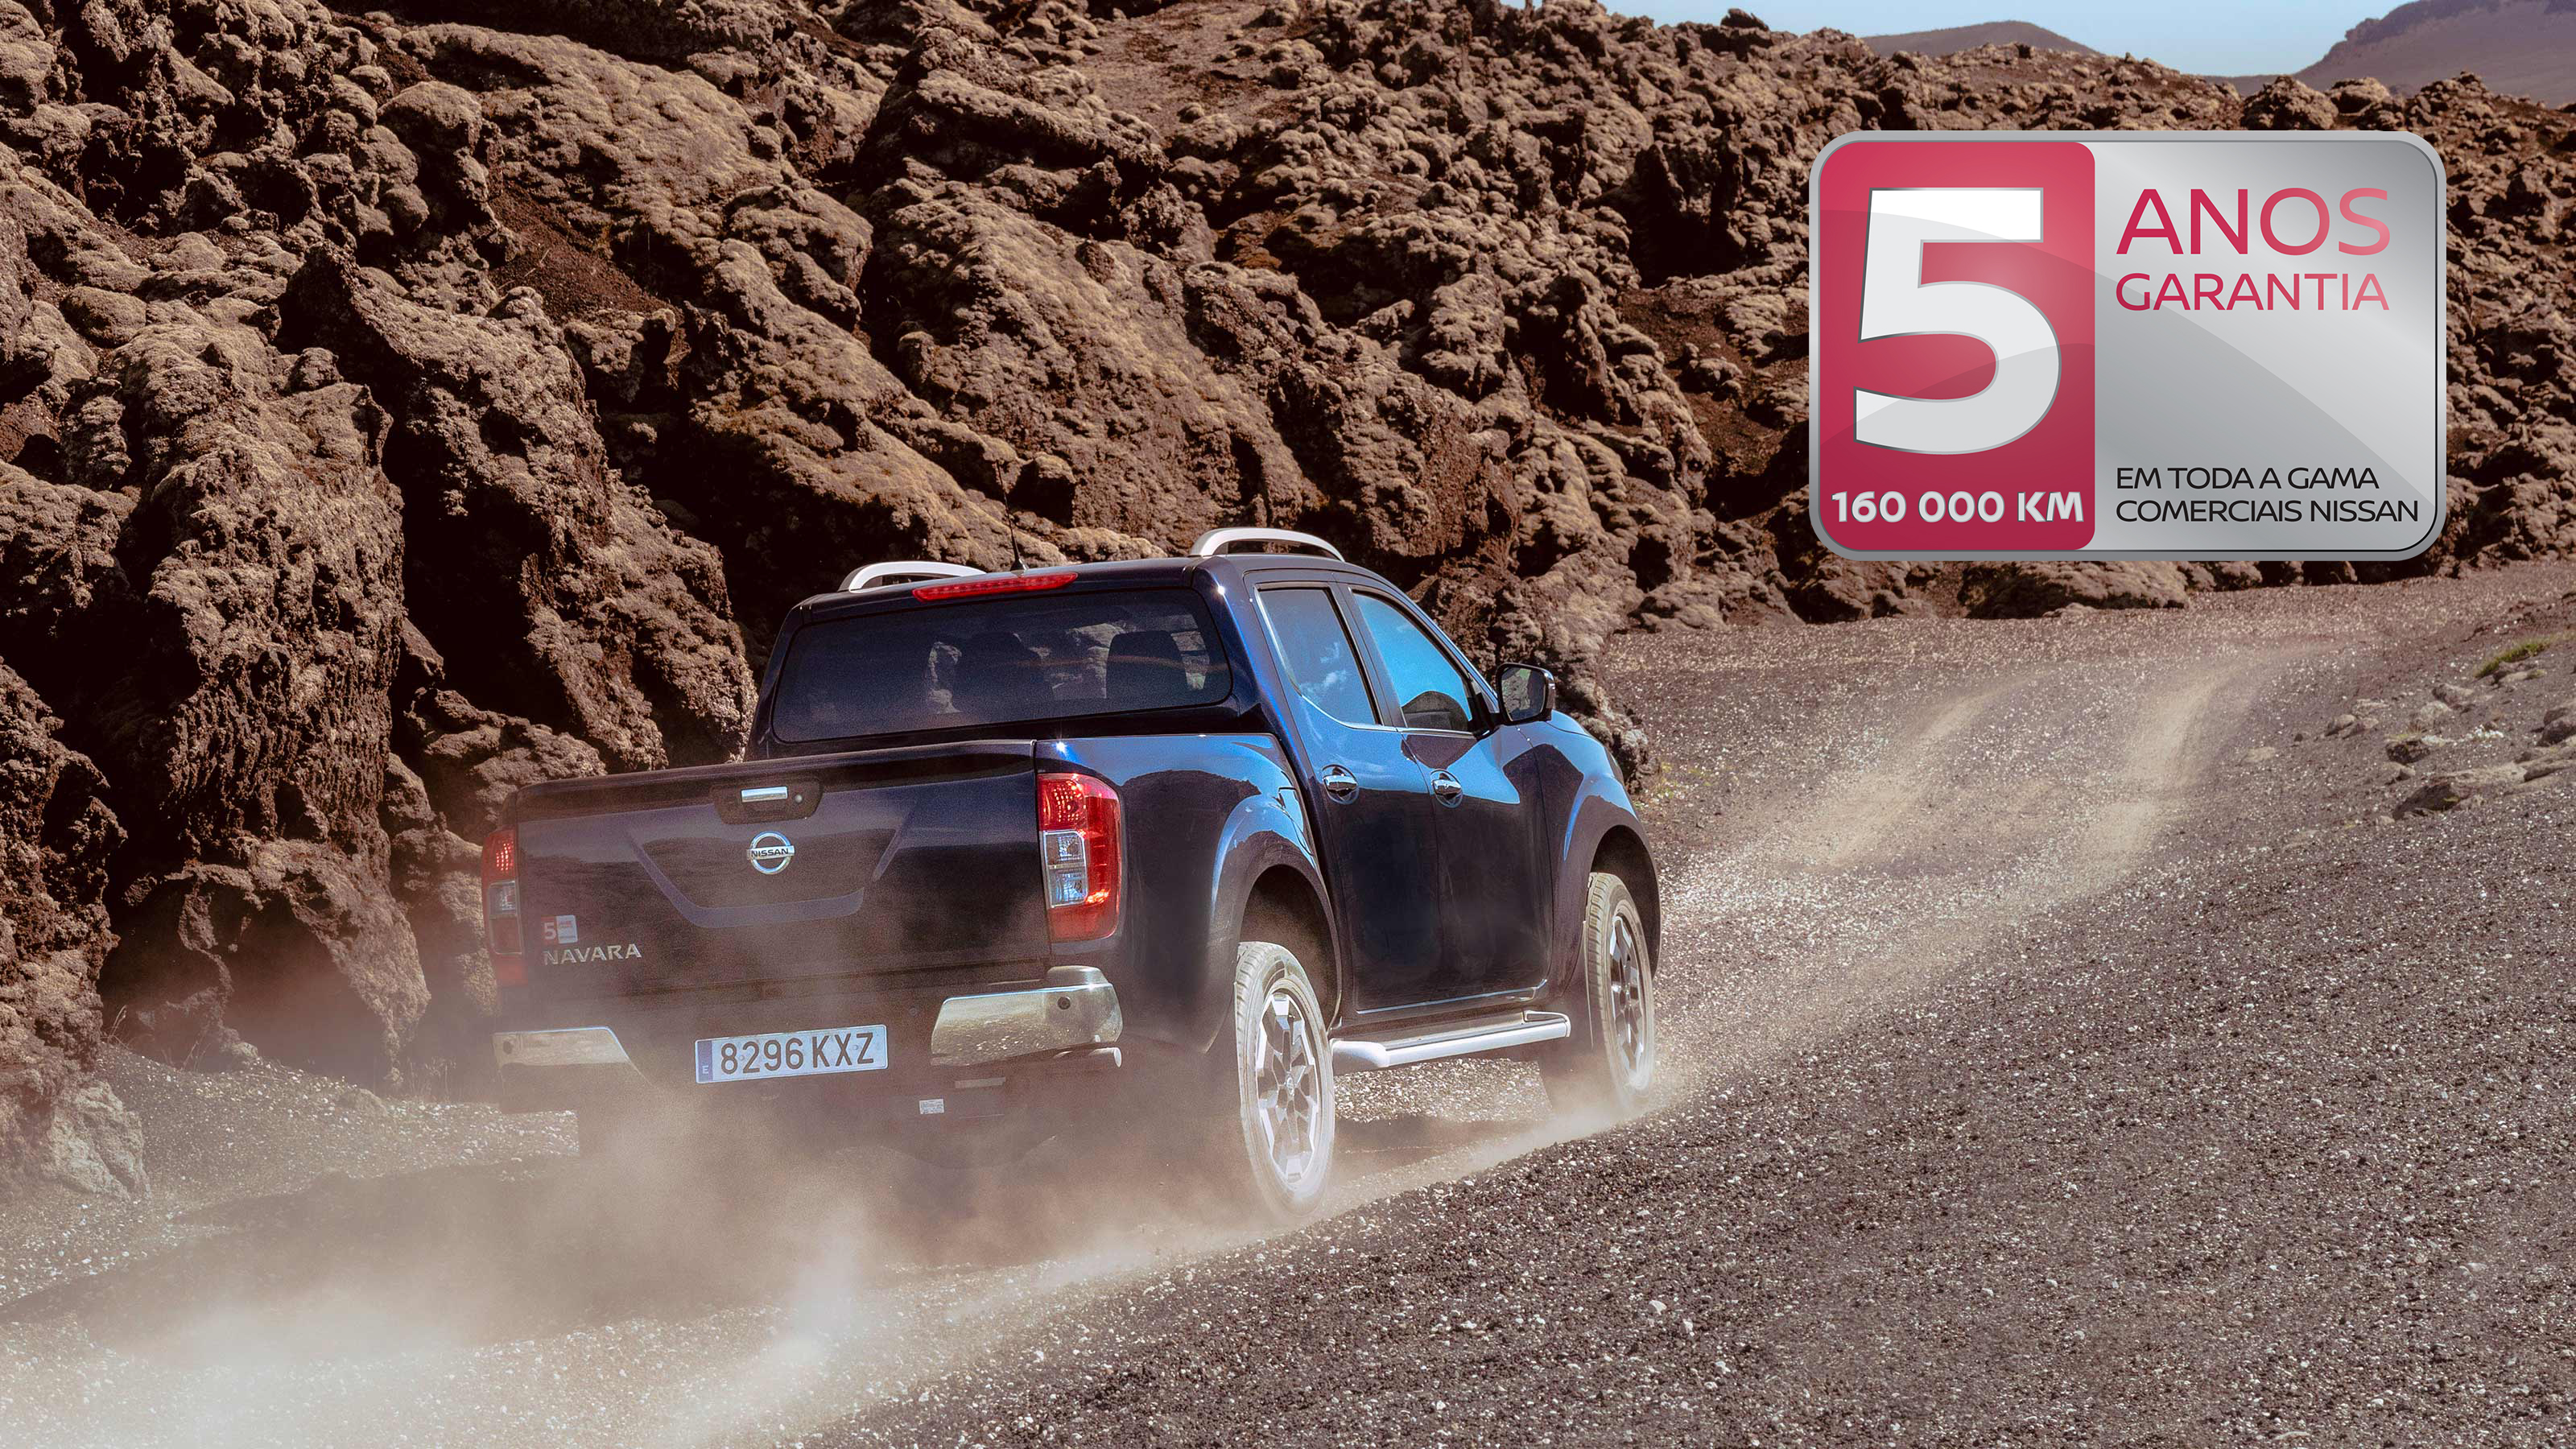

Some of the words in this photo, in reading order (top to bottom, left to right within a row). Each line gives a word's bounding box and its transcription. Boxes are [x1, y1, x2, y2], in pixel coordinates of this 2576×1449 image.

[750, 848, 789, 857] NISSAN
[543, 943, 642, 965] NAVARA
[720, 1037, 803, 1075] 8296
[811, 1032, 874, 1068] KXZ
